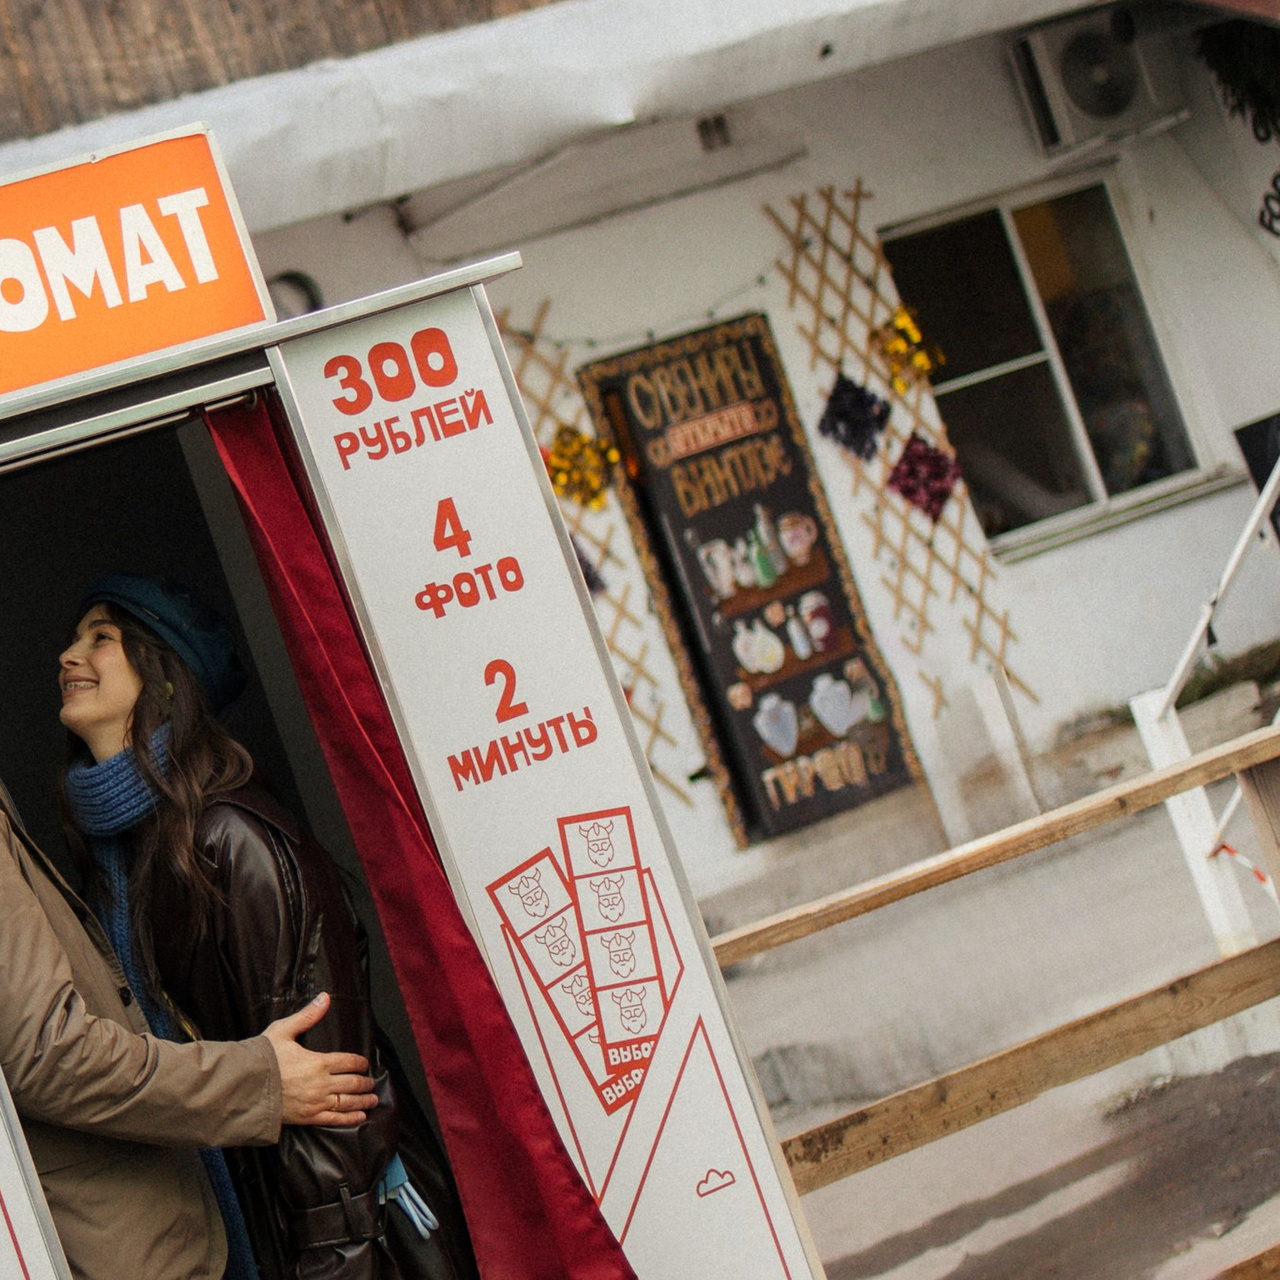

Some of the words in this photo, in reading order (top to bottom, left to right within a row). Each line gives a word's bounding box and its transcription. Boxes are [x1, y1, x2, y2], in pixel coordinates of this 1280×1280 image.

[324, 327, 458, 416] 300
[332, 387, 494, 471] РУБЛЕЙ
[432, 497, 473, 558] 4
[414, 556, 525, 619] ФОТО
[484, 658, 529, 724] 2
[447, 706, 598, 792] МИНУТЫ
[608, 1040, 655, 1066] ВЫБО
[601, 1068, 645, 1105] ВЫБО
